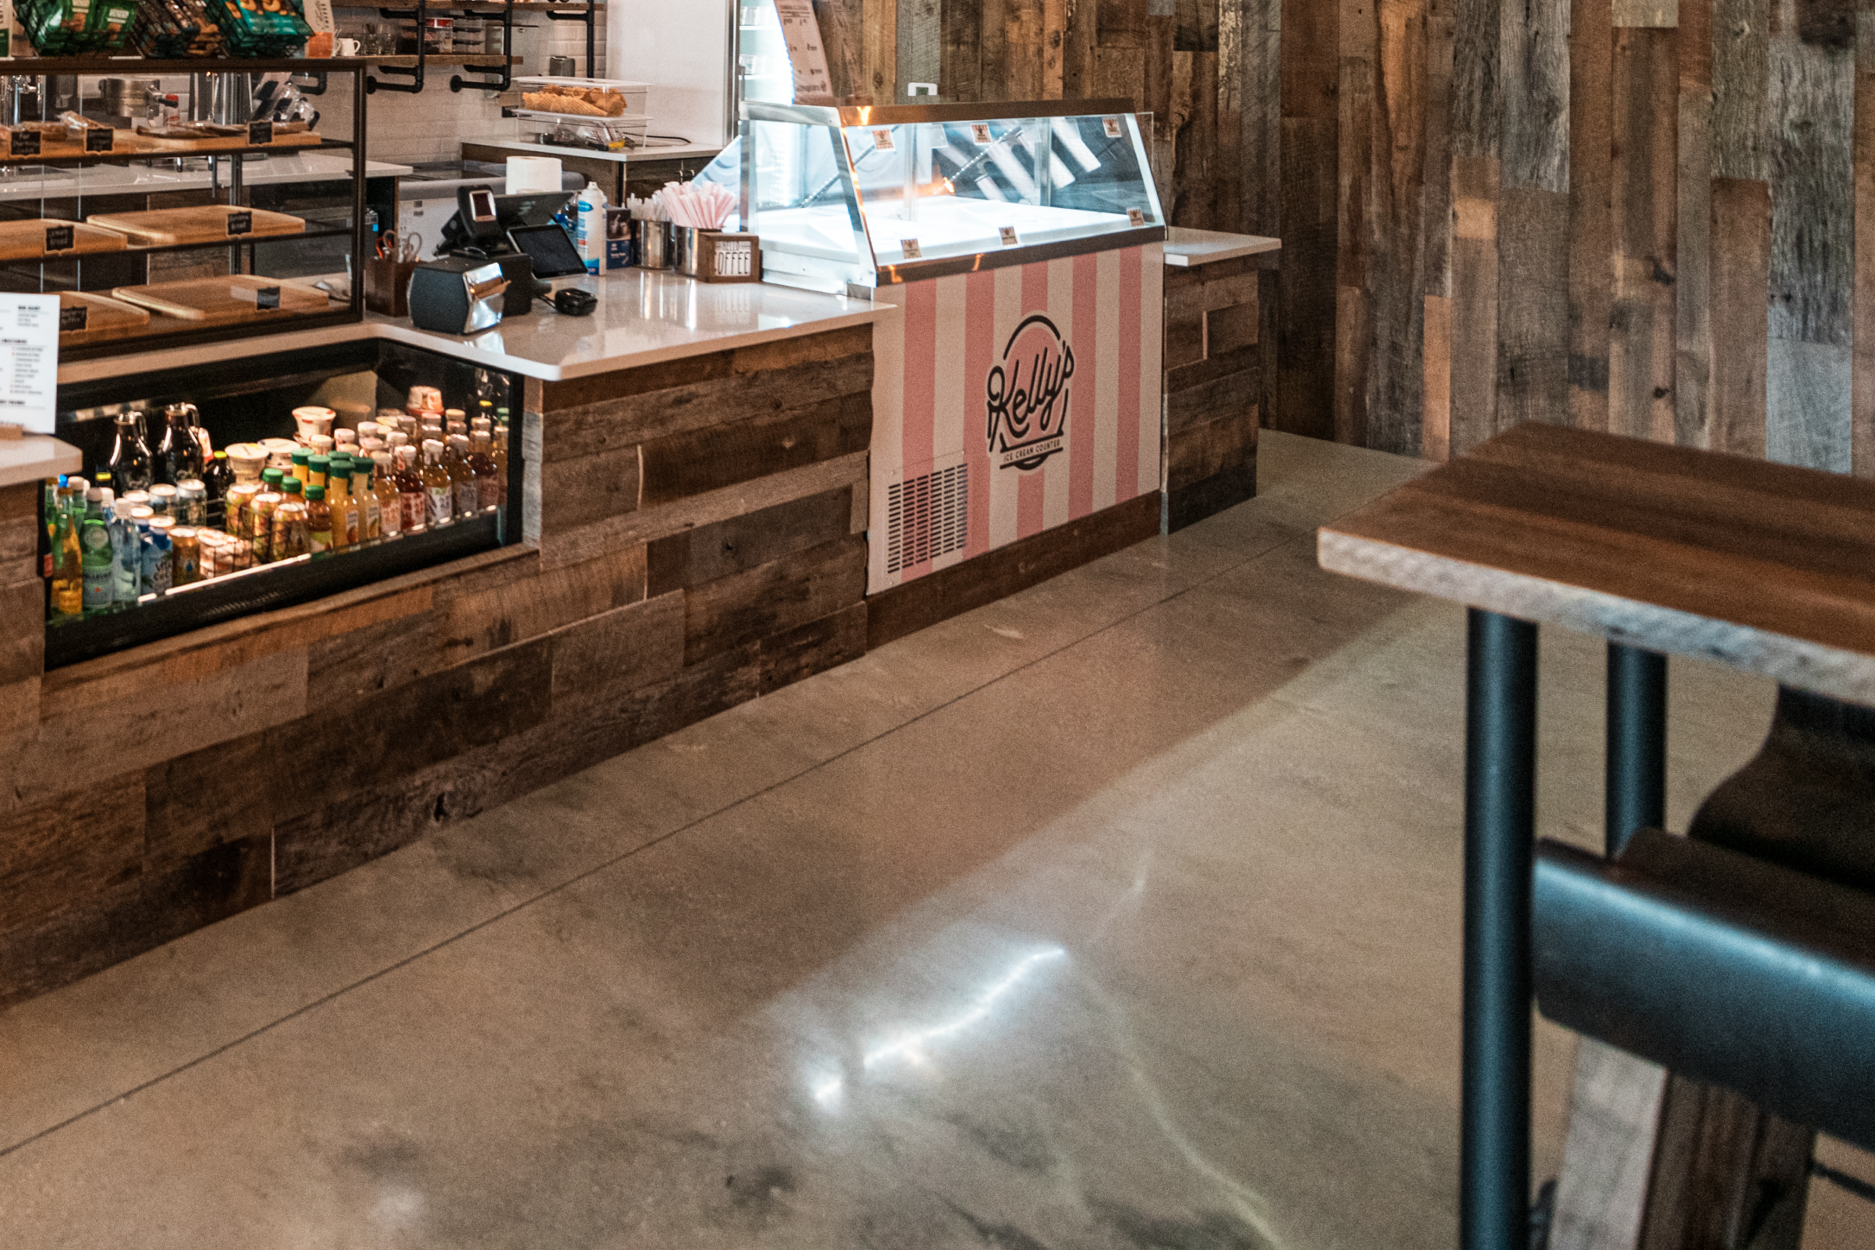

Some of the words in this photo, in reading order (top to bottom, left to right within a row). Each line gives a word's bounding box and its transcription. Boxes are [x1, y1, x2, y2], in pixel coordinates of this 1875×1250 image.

[716, 251, 751, 275] OFFEE
[986, 339, 1075, 453] Kelly's
[1003, 451, 1013, 463] ICE
[1015, 446, 1034, 460] CREAM
[1035, 438, 1061, 454] COUNTER
